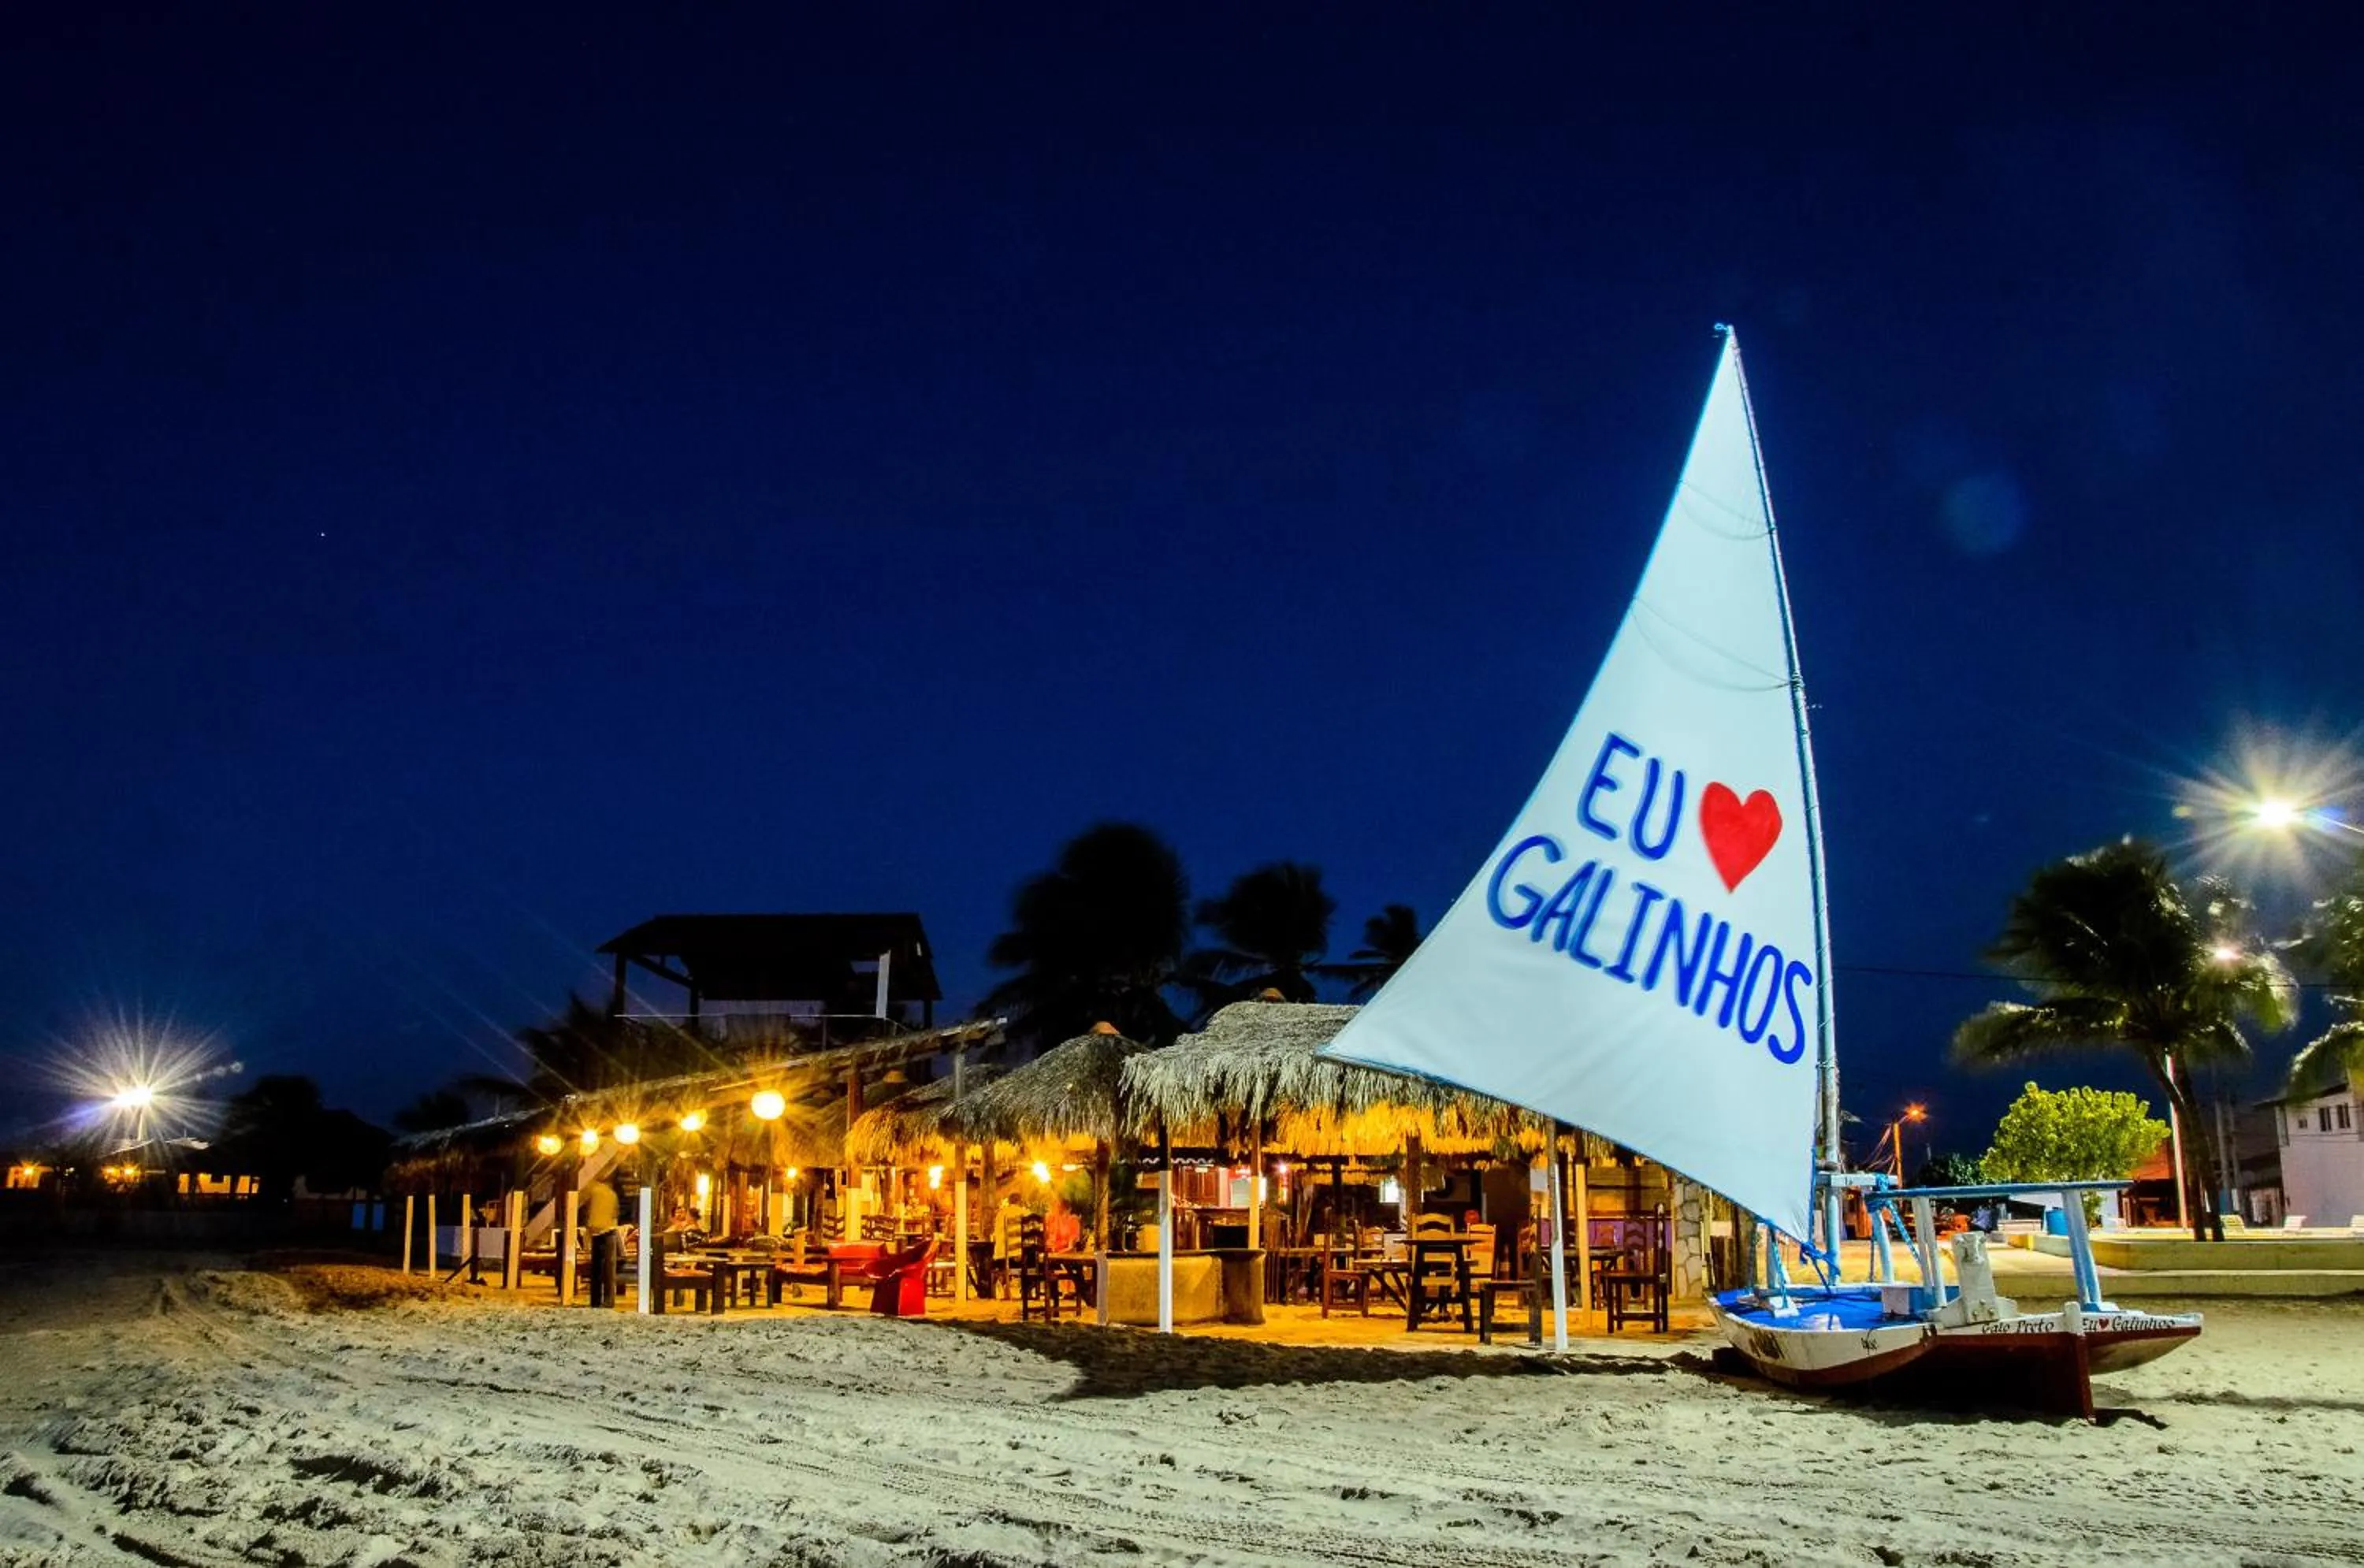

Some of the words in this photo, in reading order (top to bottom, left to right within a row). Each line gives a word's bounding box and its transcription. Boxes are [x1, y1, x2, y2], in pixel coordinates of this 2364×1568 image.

[1578, 731, 1687, 861] EU
[1487, 834, 1813, 1064] GALINHOS
[2016, 1318, 2054, 1333] Preto
[2082, 1317, 2098, 1331] Eu
[2112, 1315, 2175, 1332] Galinhos
